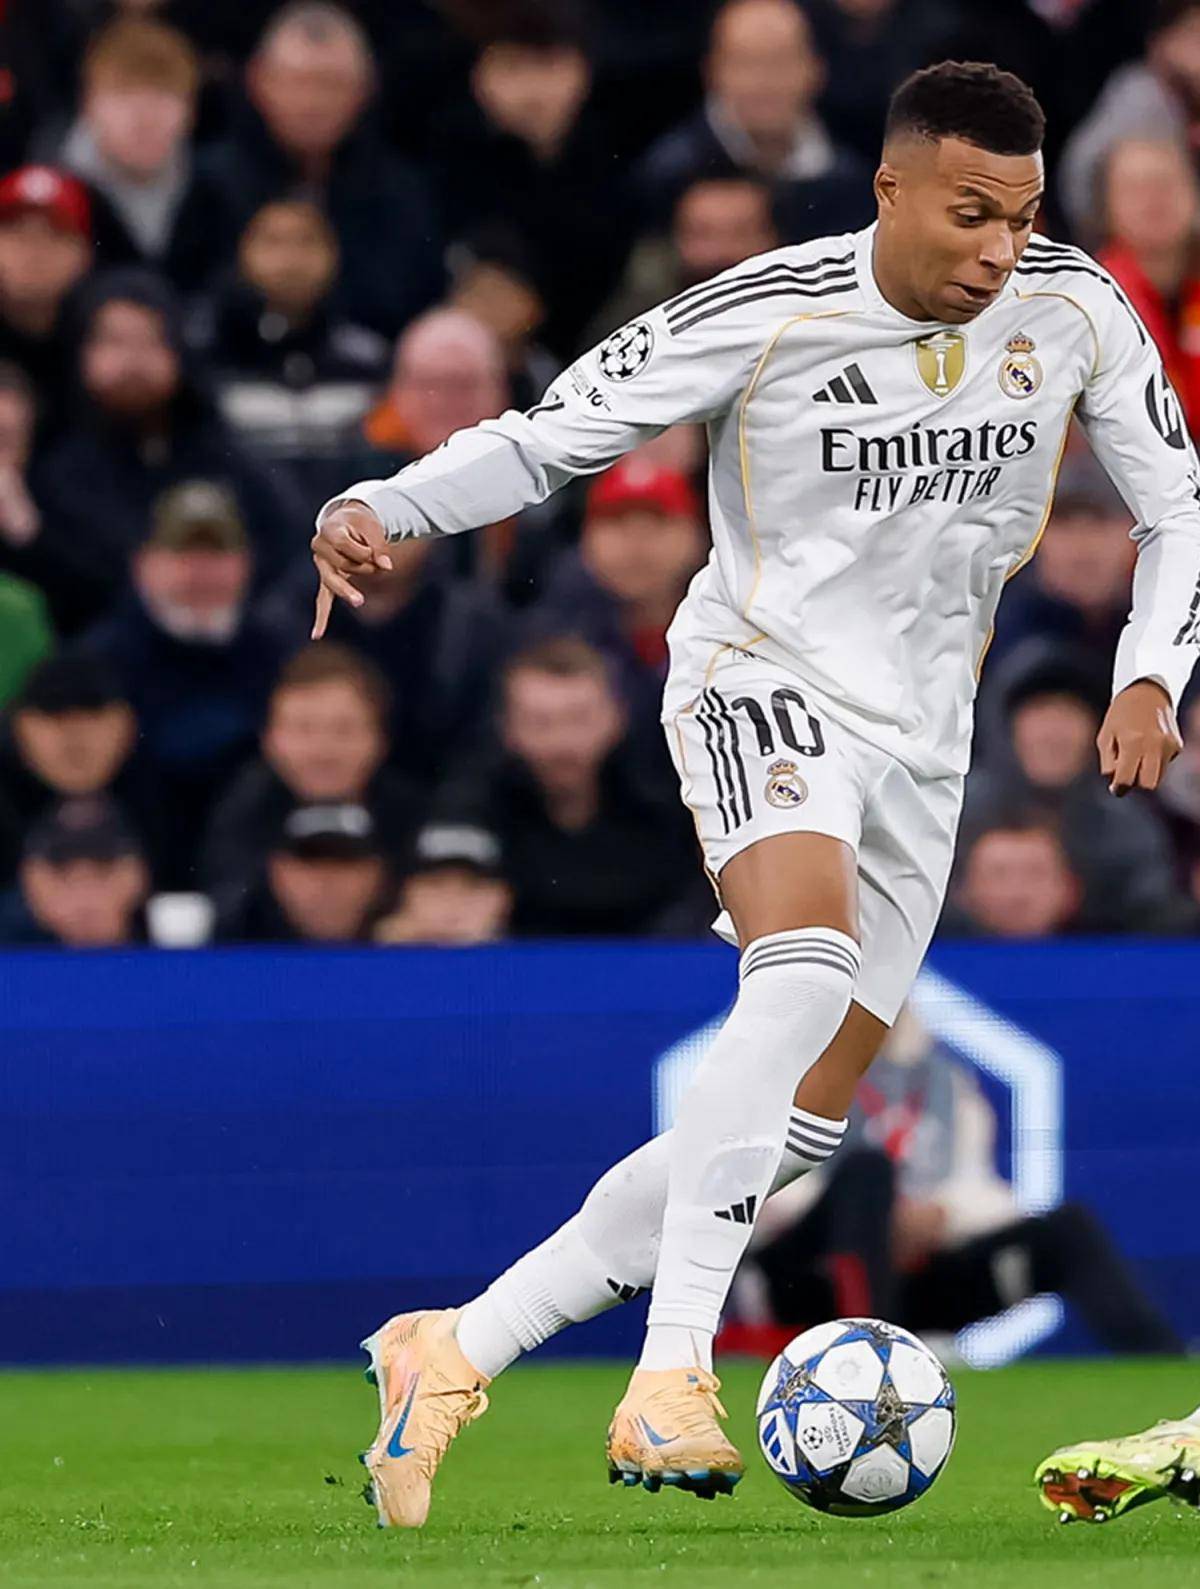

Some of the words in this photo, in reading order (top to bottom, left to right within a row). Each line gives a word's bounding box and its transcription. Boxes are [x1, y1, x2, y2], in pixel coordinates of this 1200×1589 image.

[819, 419, 1038, 472] Emirates
[853, 476, 903, 512] FLY
[907, 466, 1002, 506] BETTER
[730, 687, 826, 758] 10
